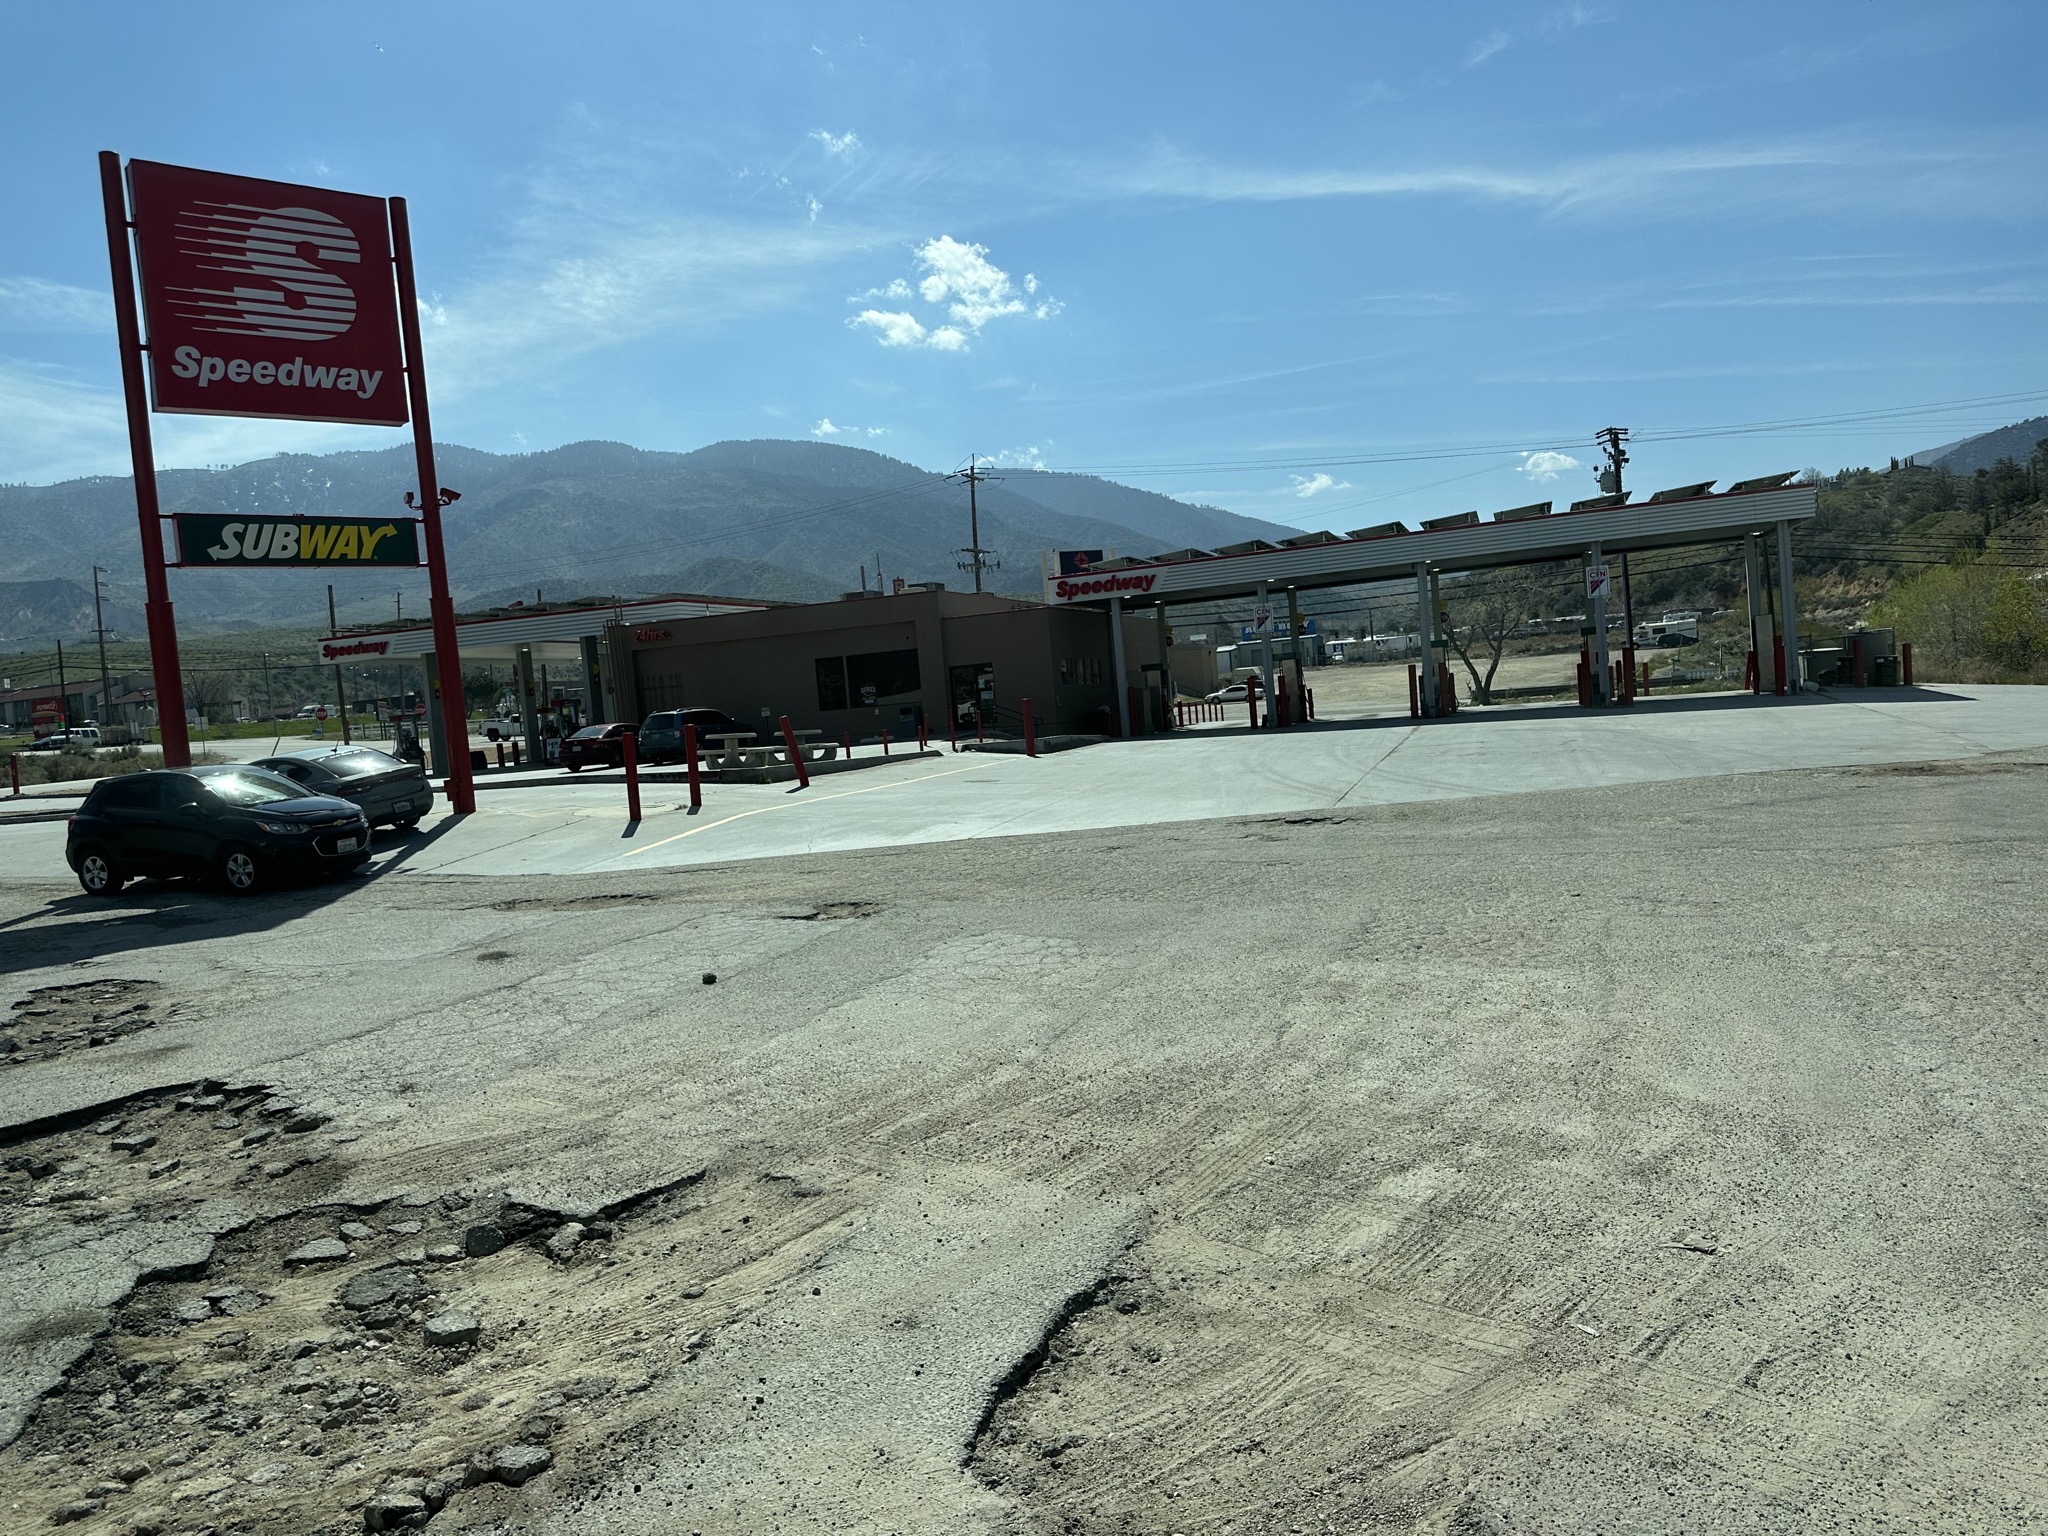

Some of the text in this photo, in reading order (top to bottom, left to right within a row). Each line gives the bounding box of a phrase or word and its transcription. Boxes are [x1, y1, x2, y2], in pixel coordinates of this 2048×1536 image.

[171, 345, 383, 399] Speedway
[206, 522, 398, 561] SUBWAY
[1056, 574, 1157, 600] Speedway
[1589, 570, 1606, 579] CFN
[322, 641, 389, 661] Speedway
